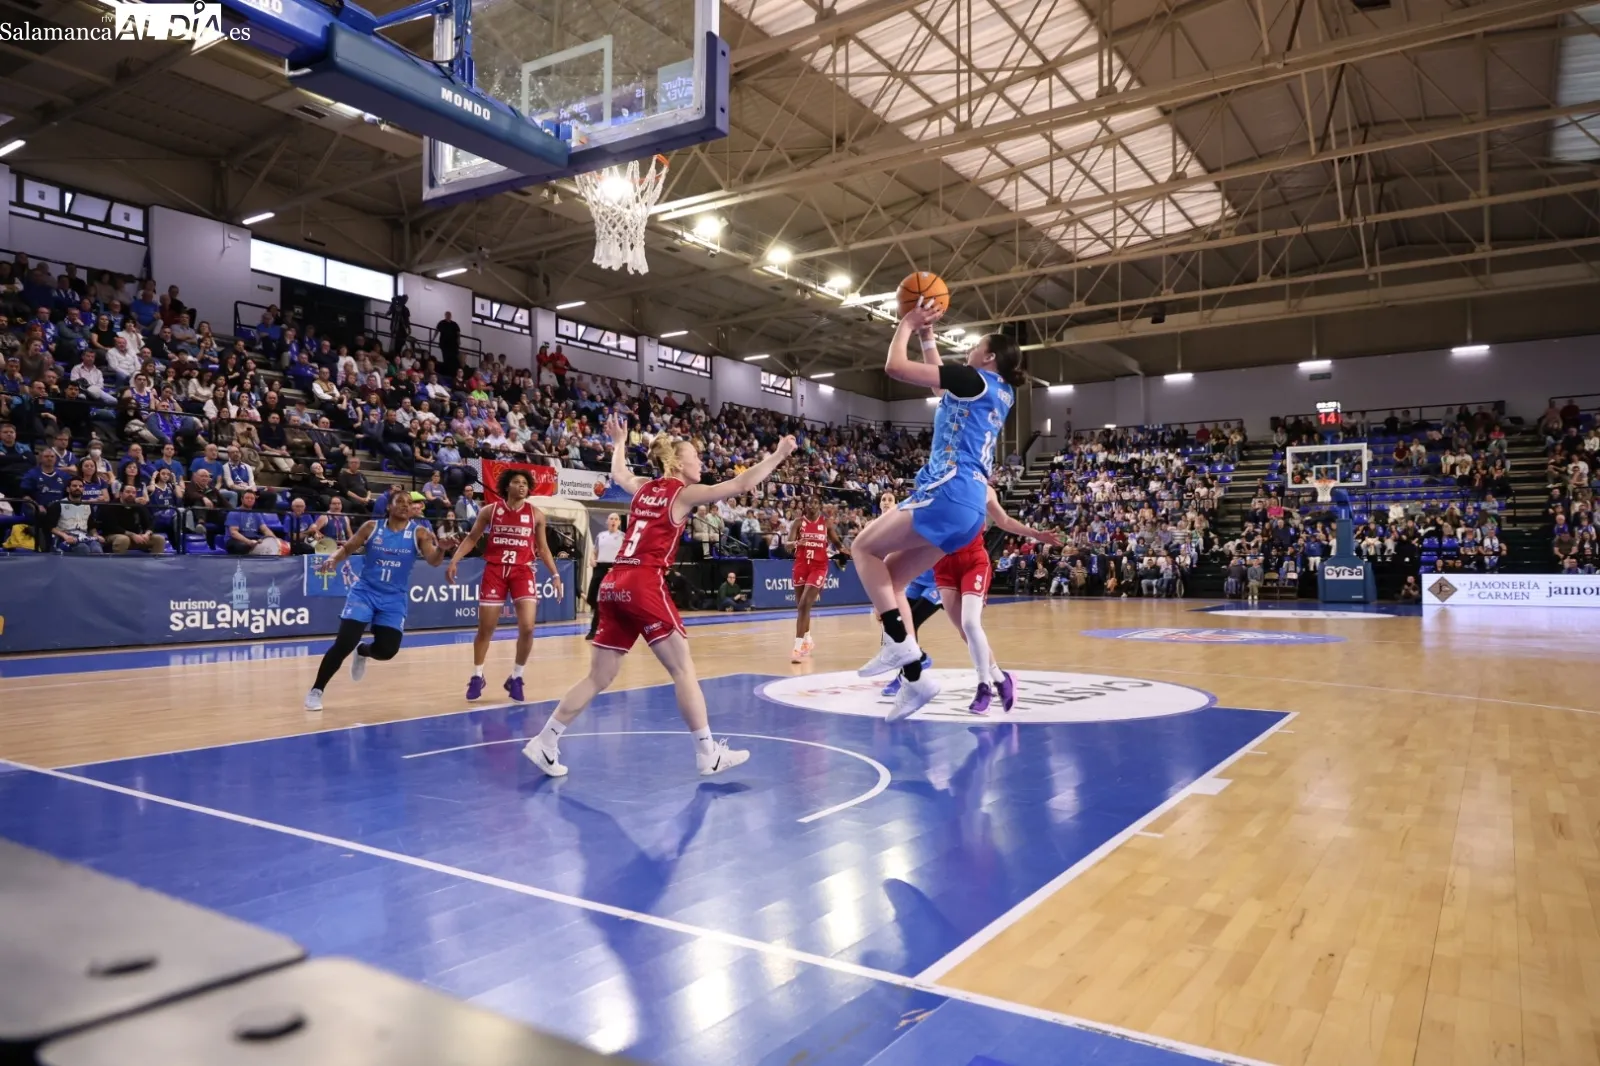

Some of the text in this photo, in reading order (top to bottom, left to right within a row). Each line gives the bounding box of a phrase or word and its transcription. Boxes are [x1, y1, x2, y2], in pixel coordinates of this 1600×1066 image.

[440, 87, 492, 121] MONDO
[1318, 411, 1337, 425] 14
[560, 479, 593, 490] Ayuntamiento
[568, 490, 593, 498] Salamanca
[638, 493, 669, 507] HOLM
[494, 527, 522, 535] SPAR
[493, 537, 529, 547] GIRONA
[623, 520, 649, 558] 5
[501, 550, 517, 564] 23
[806, 549, 815, 559] 21
[380, 568, 391, 582] 11
[823, 573, 840, 589] EÓN
[1468, 580, 1541, 590] JAMONERÍA
[410, 585, 479, 603] CASTILL
[1477, 591, 1530, 601] CARMEN
[170, 599, 216, 610] turismo
[455, 607, 477, 618] NOS
